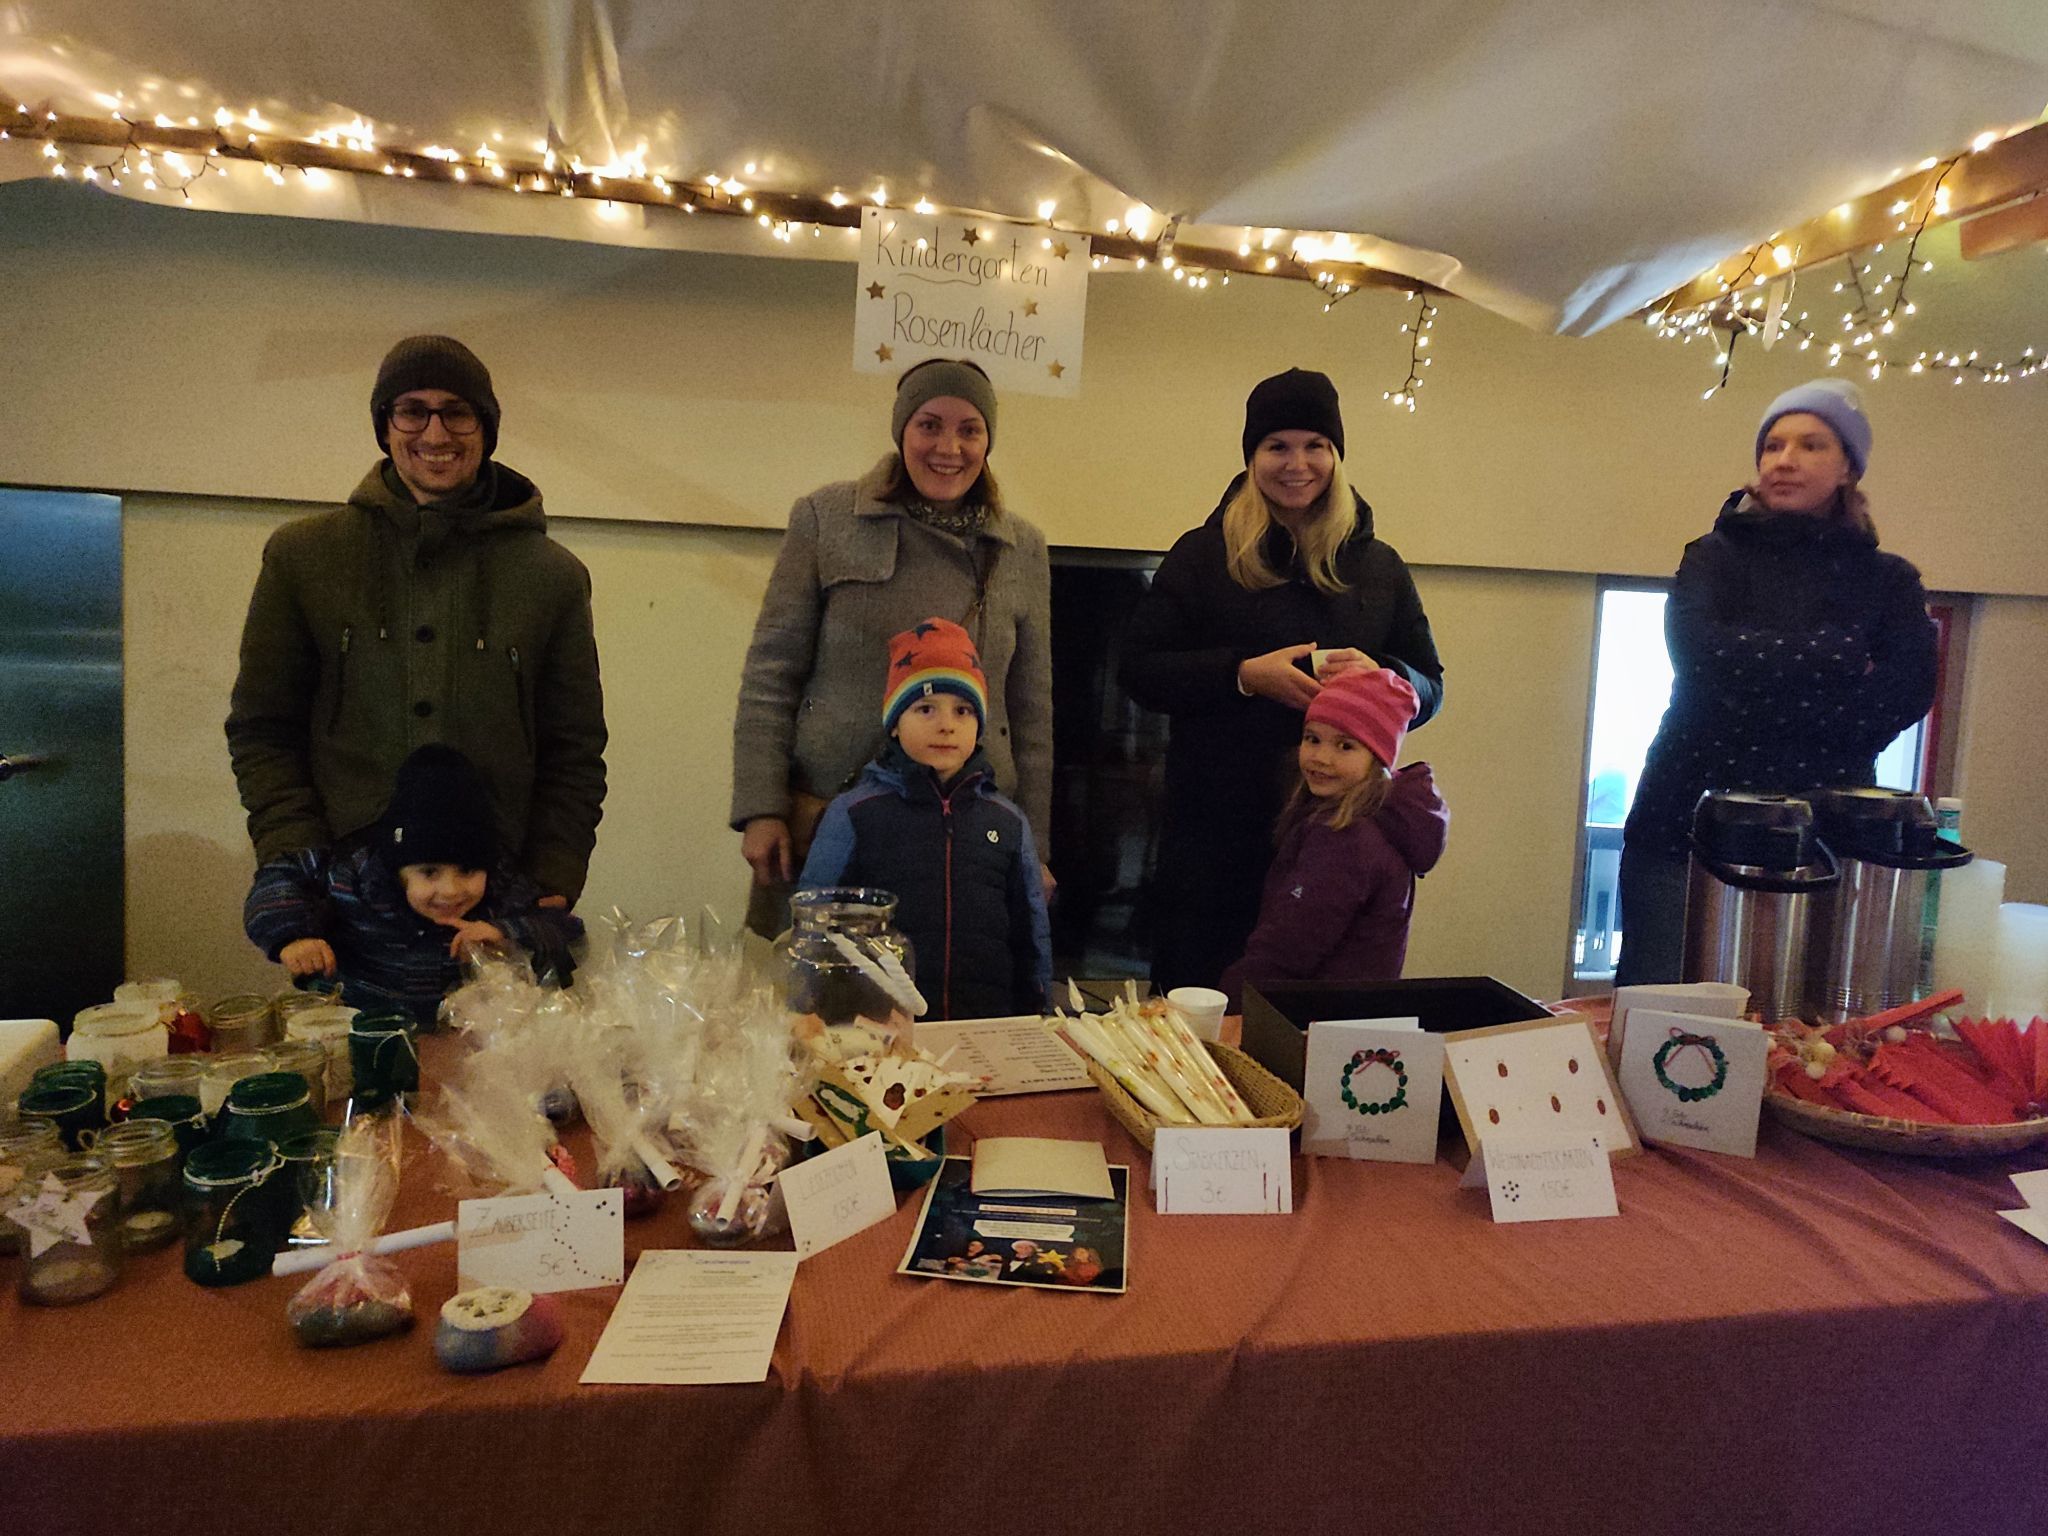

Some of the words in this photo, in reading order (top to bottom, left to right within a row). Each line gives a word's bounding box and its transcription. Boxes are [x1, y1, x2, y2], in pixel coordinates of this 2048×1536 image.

[877, 220, 1049, 288] Kindergarten
[892, 291, 1048, 362] Rosenlächer
[1199, 1179, 1227, 1204] 3€
[536, 1252, 566, 1278] 5€
